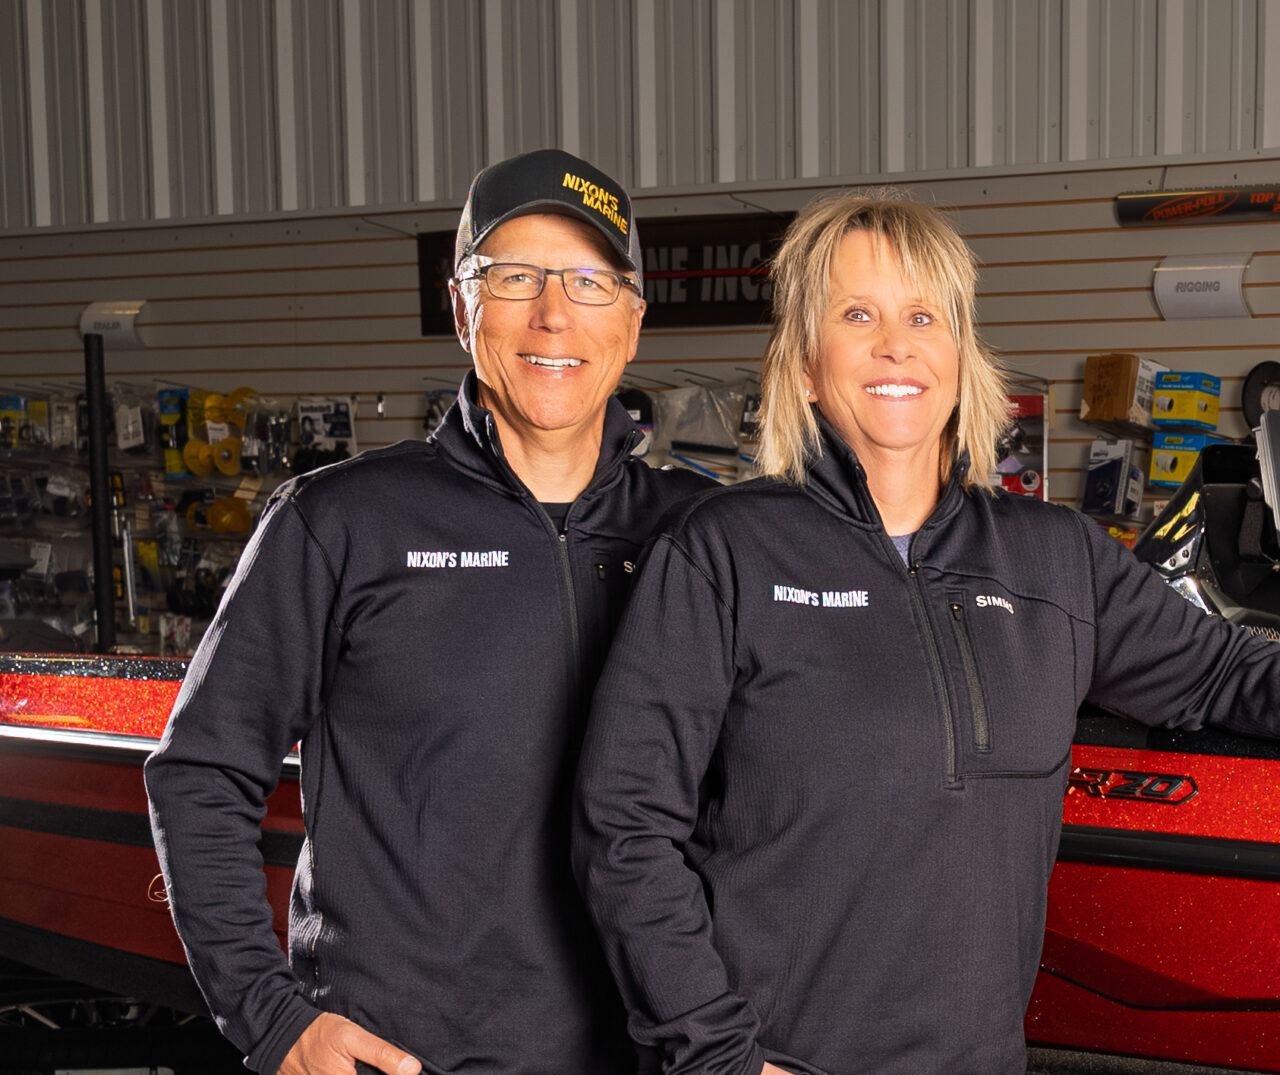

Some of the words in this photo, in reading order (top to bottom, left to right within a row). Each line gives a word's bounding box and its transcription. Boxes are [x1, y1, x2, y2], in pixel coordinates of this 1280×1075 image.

[563, 173, 619, 211] NIXON'S
[1250, 191, 1274, 204] TOP
[583, 193, 628, 235] MARINE
[1151, 193, 1226, 220] POWER-POLE
[701, 241, 770, 303] INC.
[1175, 281, 1221, 293] RIGGING
[407, 551, 458, 569] NIXON'S
[460, 550, 509, 568] MARINE
[773, 584, 820, 607] NIXON'S
[822, 590, 869, 608] MARINE
